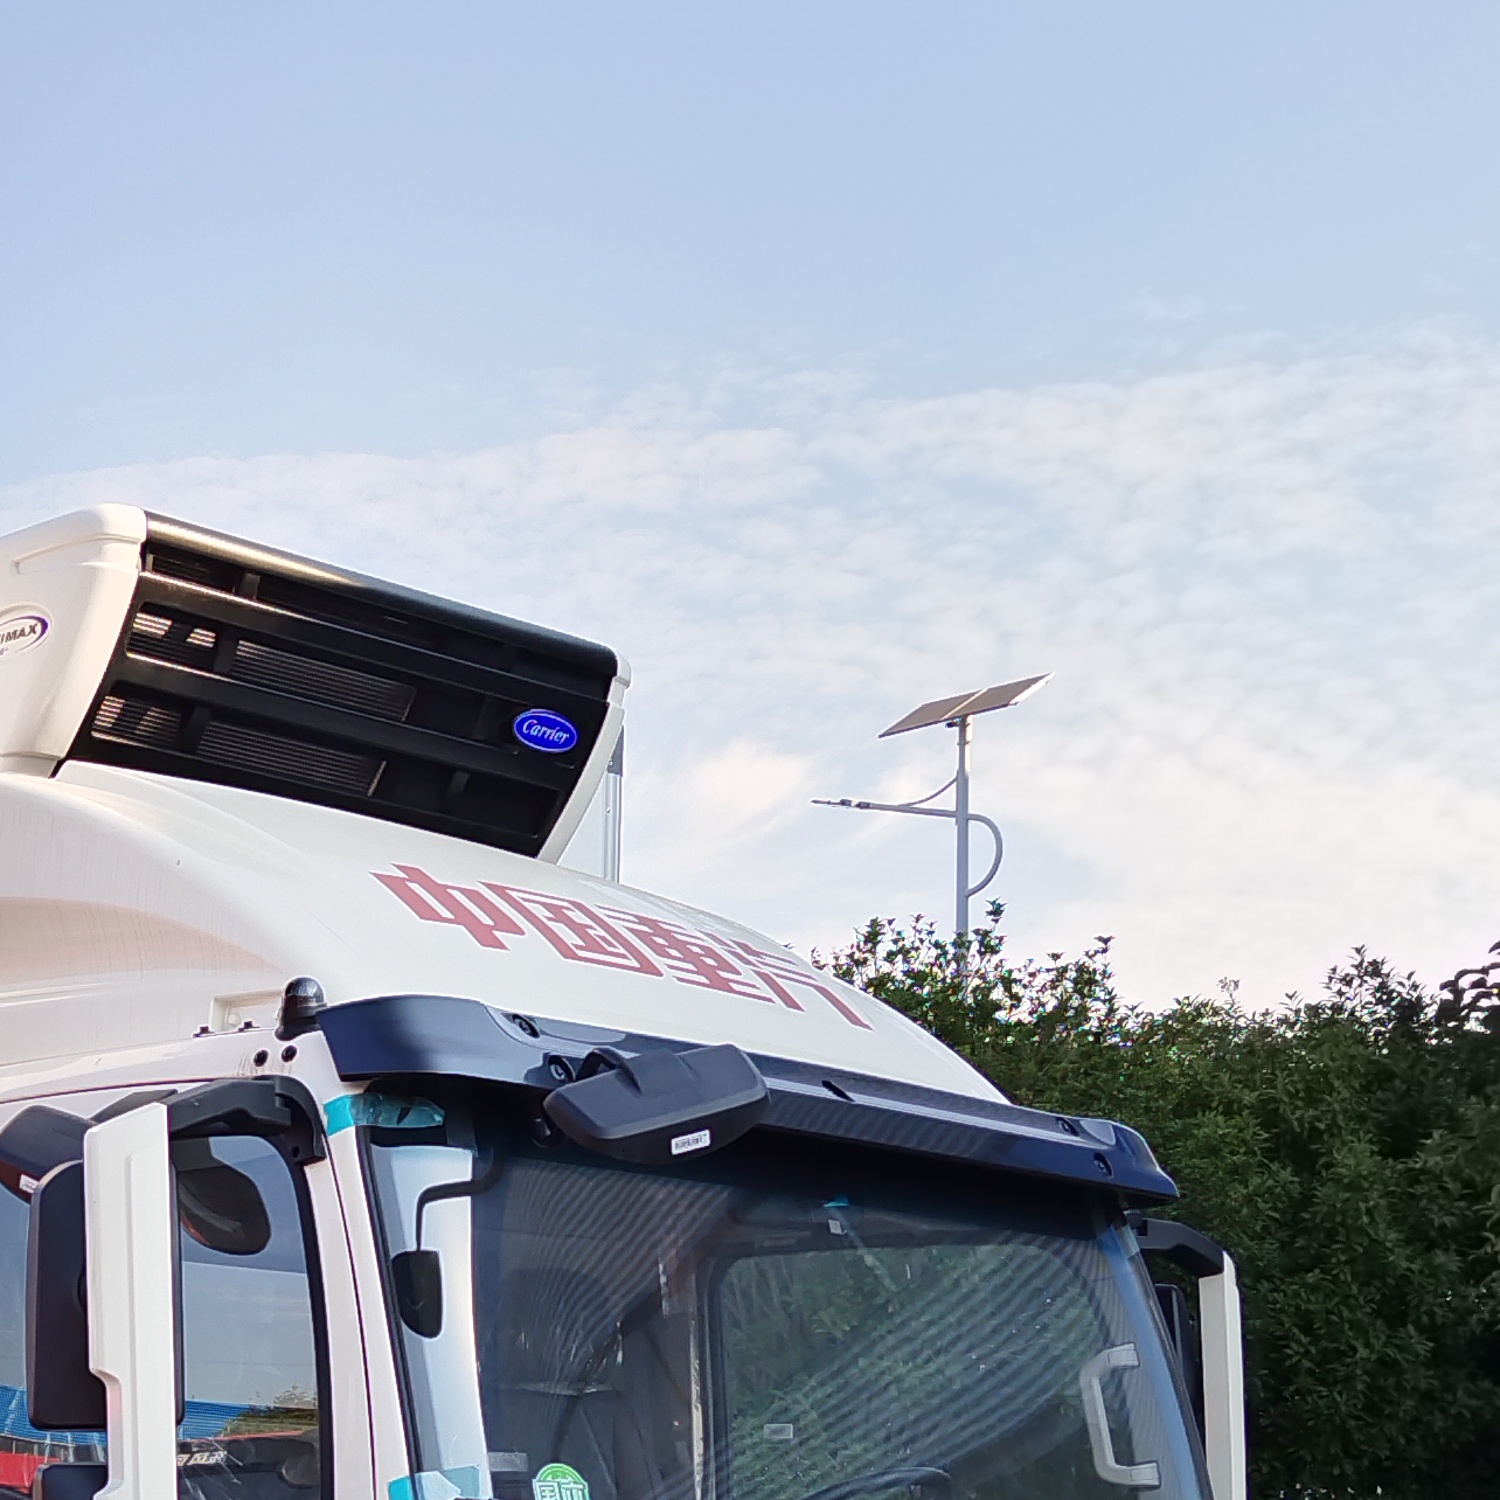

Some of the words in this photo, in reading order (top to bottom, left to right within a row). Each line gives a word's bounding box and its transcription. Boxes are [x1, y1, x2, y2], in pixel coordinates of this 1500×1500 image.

[522, 719, 570, 744] Carrier
[369, 862, 874, 1031] 中国重汽
